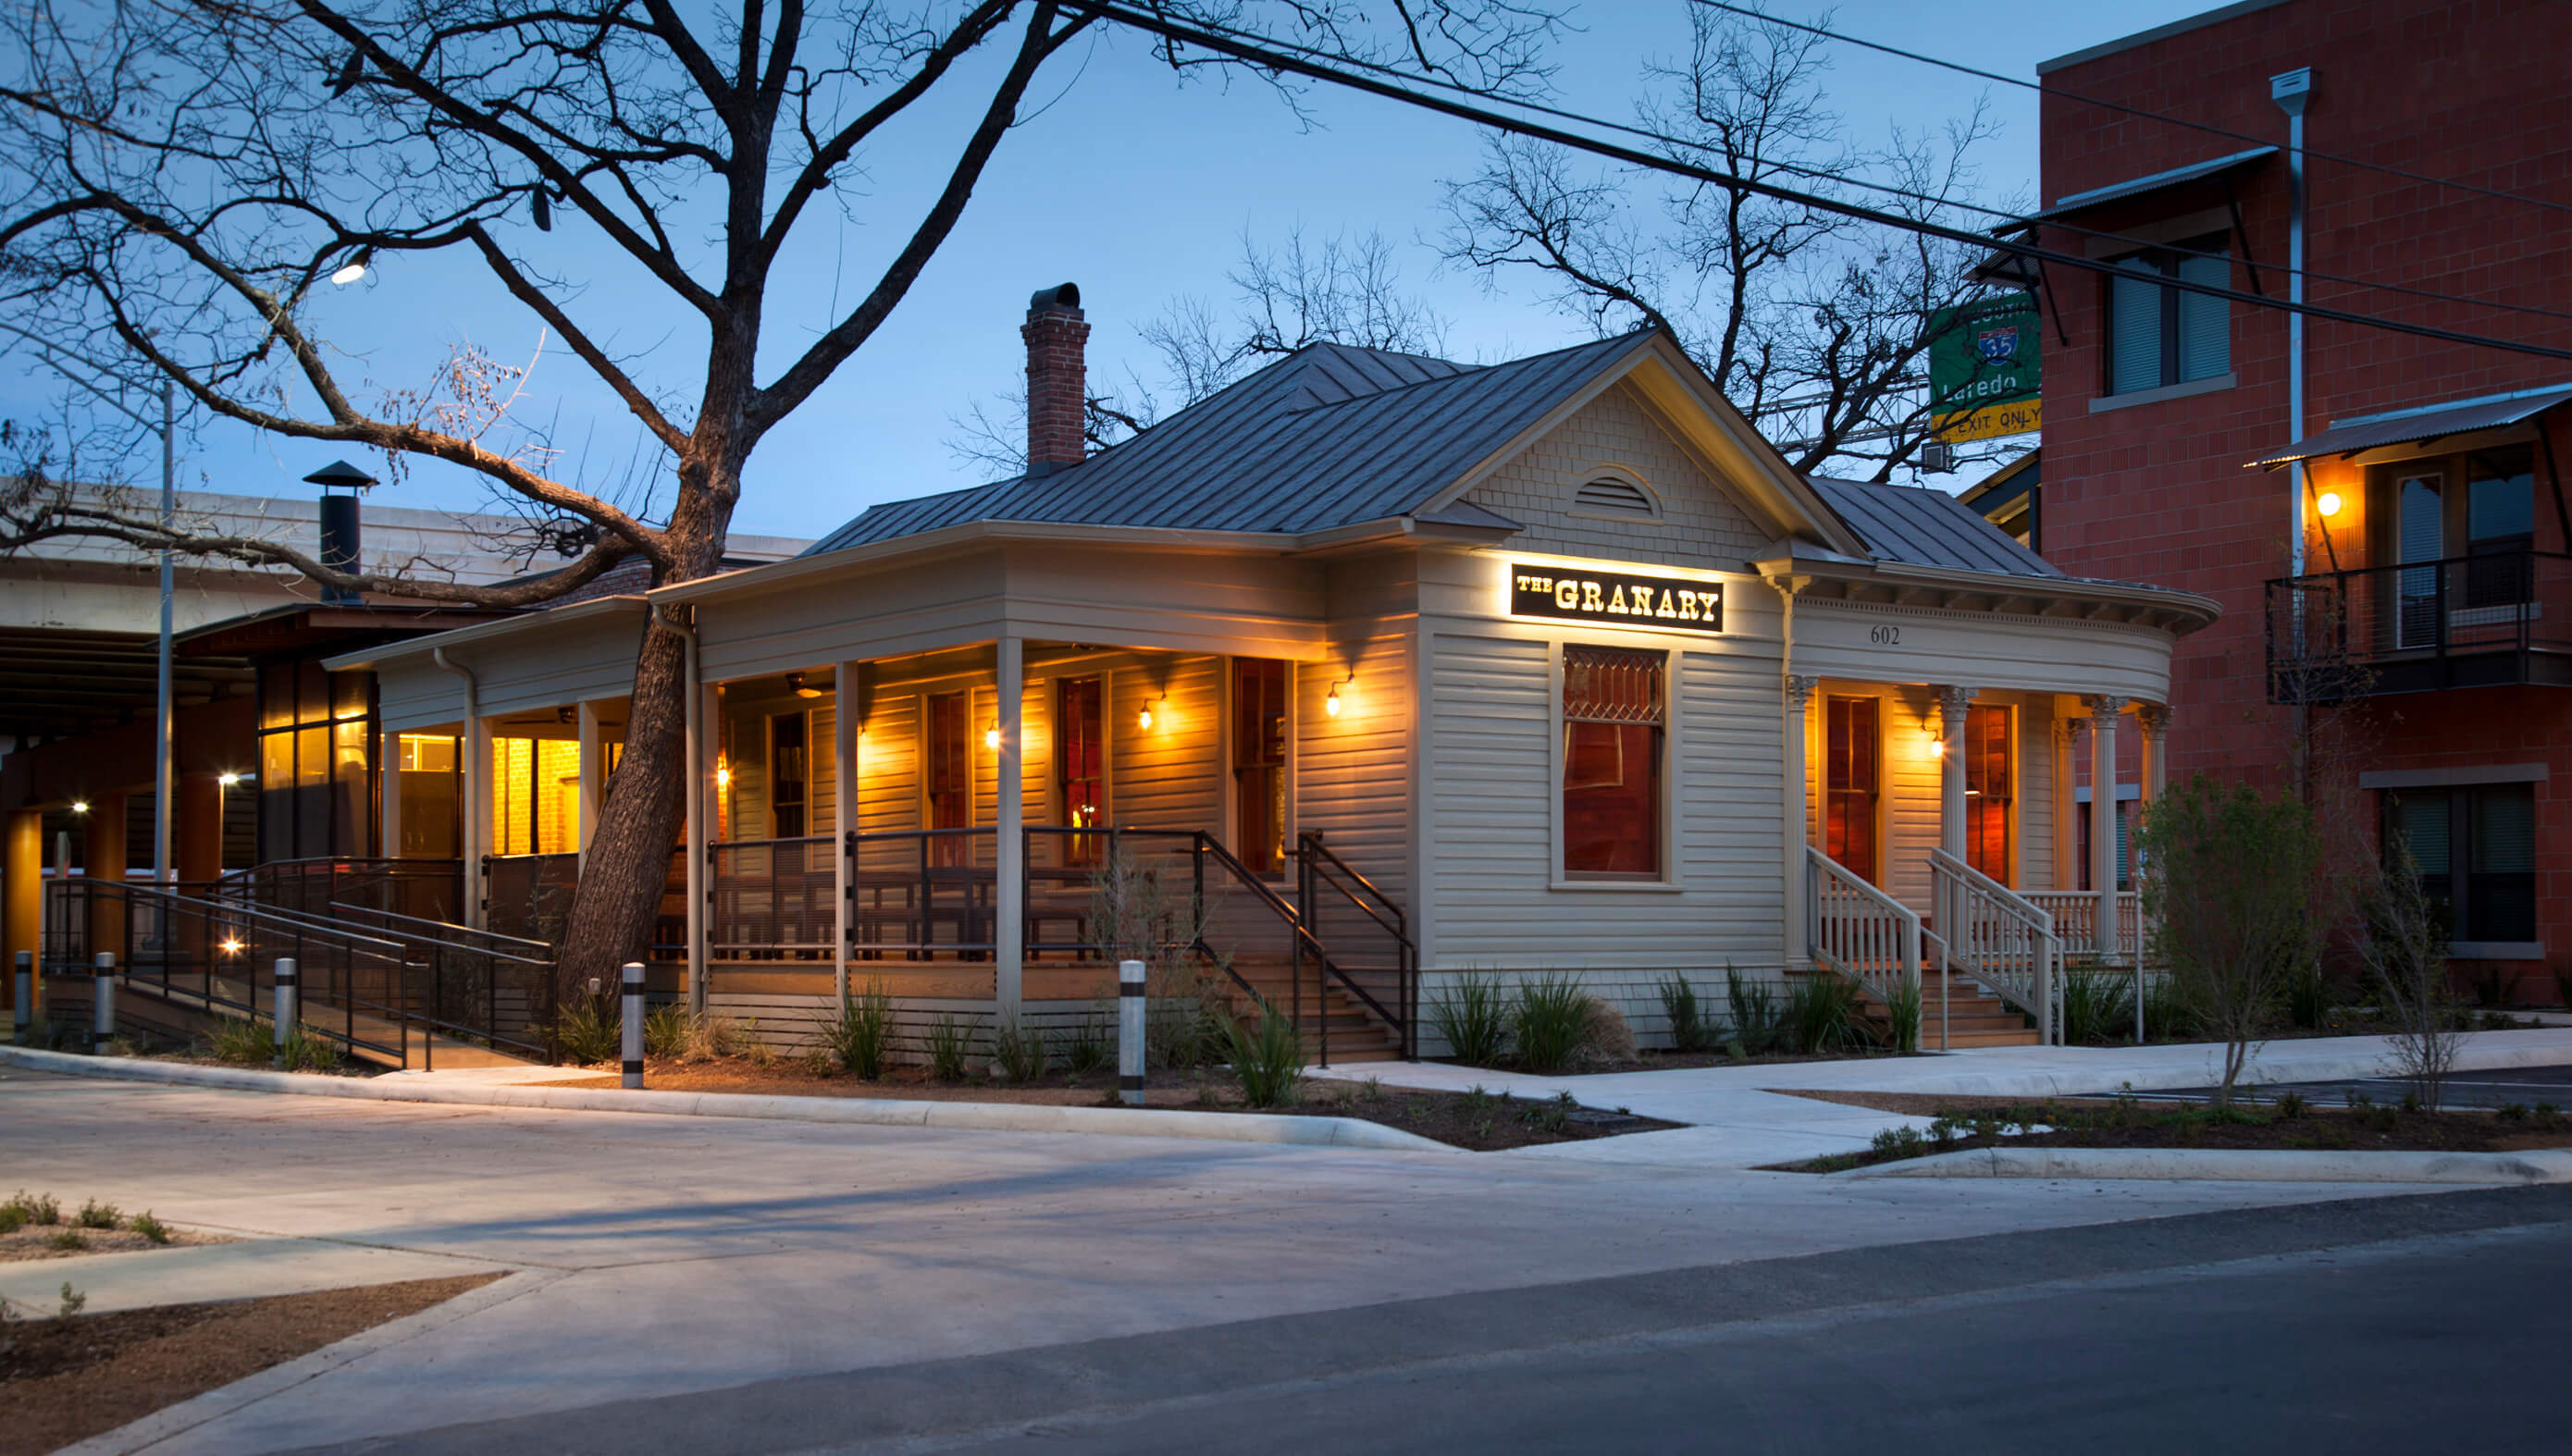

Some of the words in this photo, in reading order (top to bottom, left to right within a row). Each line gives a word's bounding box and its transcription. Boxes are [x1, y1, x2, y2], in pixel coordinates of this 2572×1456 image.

[1986, 337, 2012, 357] 35
[1944, 374, 2016, 401] Laredo
[1958, 415, 1991, 434] EXIT
[2000, 408, 2042, 428] ONLY
[1516, 575, 1552, 593] THE
[1555, 580, 1719, 622] GRANARY
[1871, 625, 1899, 644] 602
